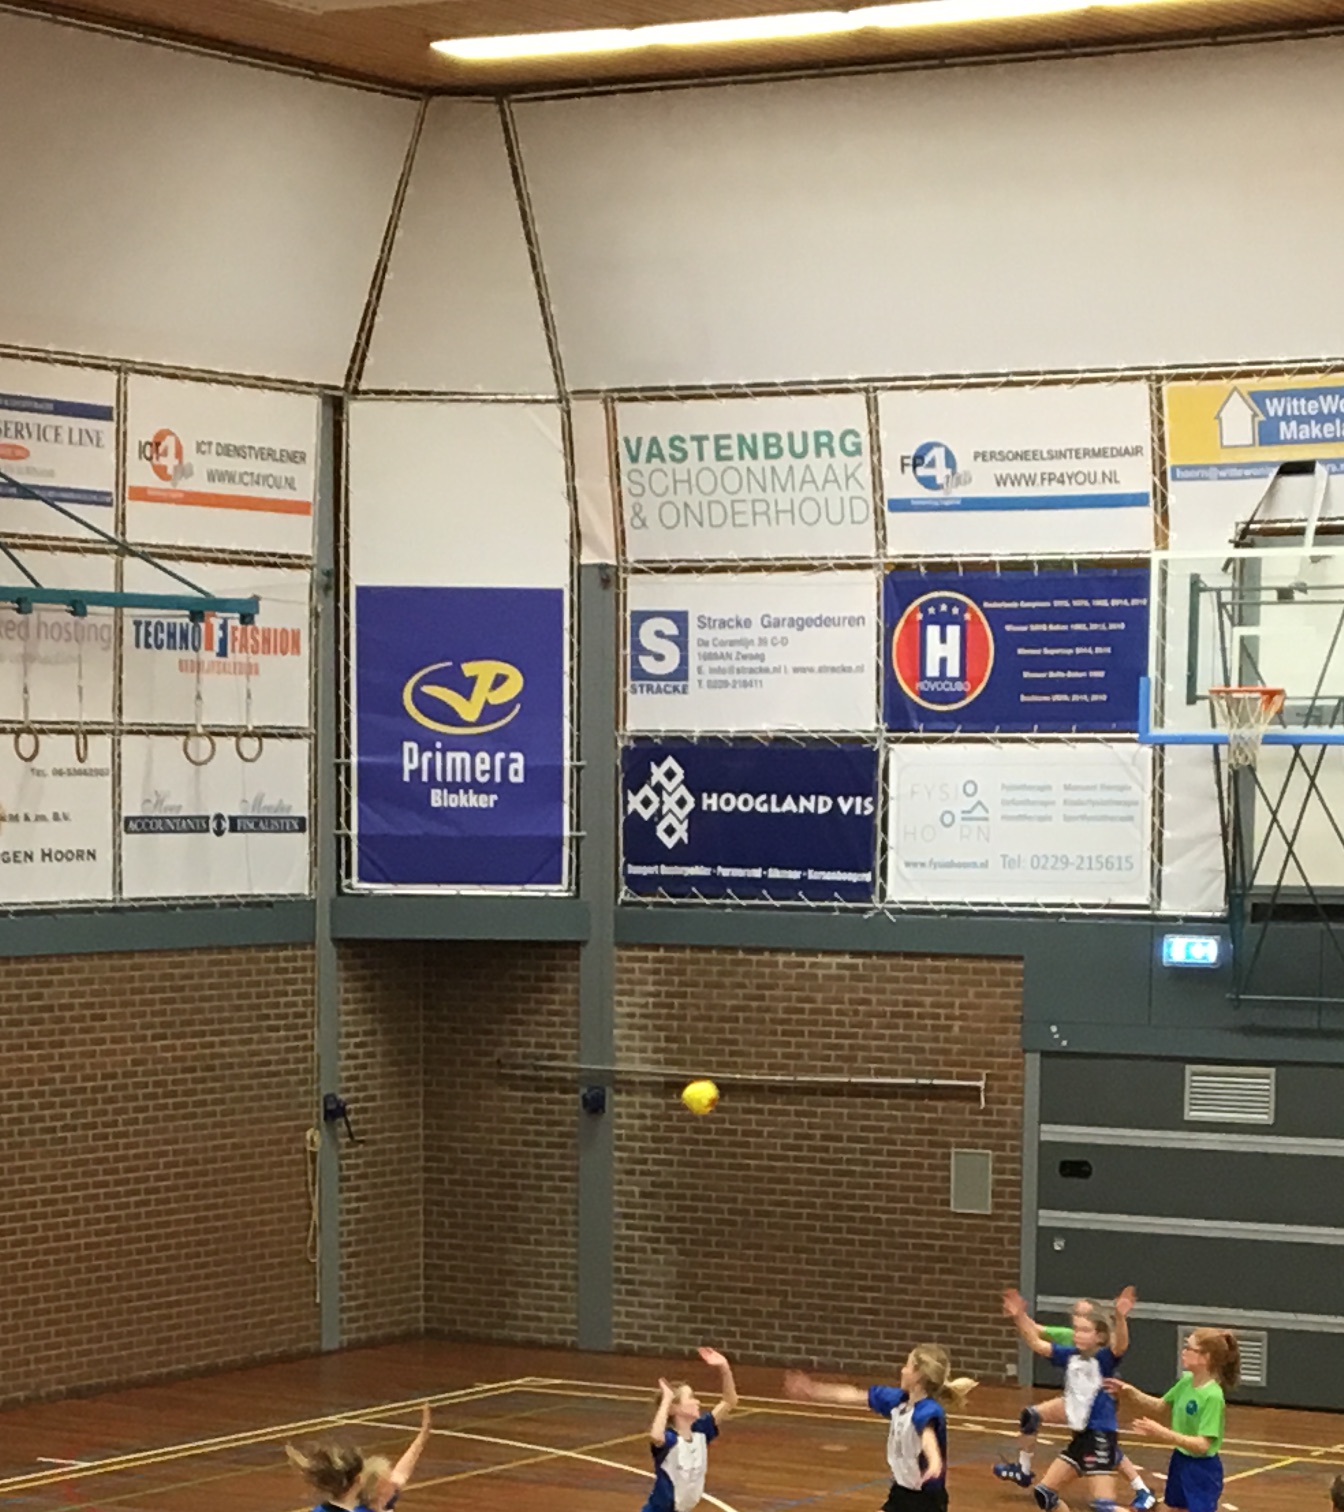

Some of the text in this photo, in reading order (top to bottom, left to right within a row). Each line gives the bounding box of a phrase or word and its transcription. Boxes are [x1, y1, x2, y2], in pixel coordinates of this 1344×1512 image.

[68, 426, 105, 449] LINE
[624, 428, 863, 464] VASTENBURG
[196, 440, 306, 465] ICT DIENSTVERLENER
[973, 445, 1144, 463] PERSONEELSINTERMEDIAIR
[206, 469, 297, 491] WWW.ICT4YOU.NL
[627, 461, 865, 498] SCHOONMAAK
[994, 470, 1120, 487] WWW.FP4YOU.NL
[630, 495, 870, 530] & ONDERHOUD
[696, 613, 865, 632] Stracke Garagedeuren
[133, 619, 301, 656] TECHNO FASHION
[638, 616, 680, 675] S
[926, 625, 960, 677] H
[630, 683, 689, 695] STRACKE
[402, 741, 525, 783] Primera
[430, 788, 499, 808] Blokker
[701, 792, 875, 815] HOOGLAND VIS
[1030, 855, 1135, 872] 0229-215615
